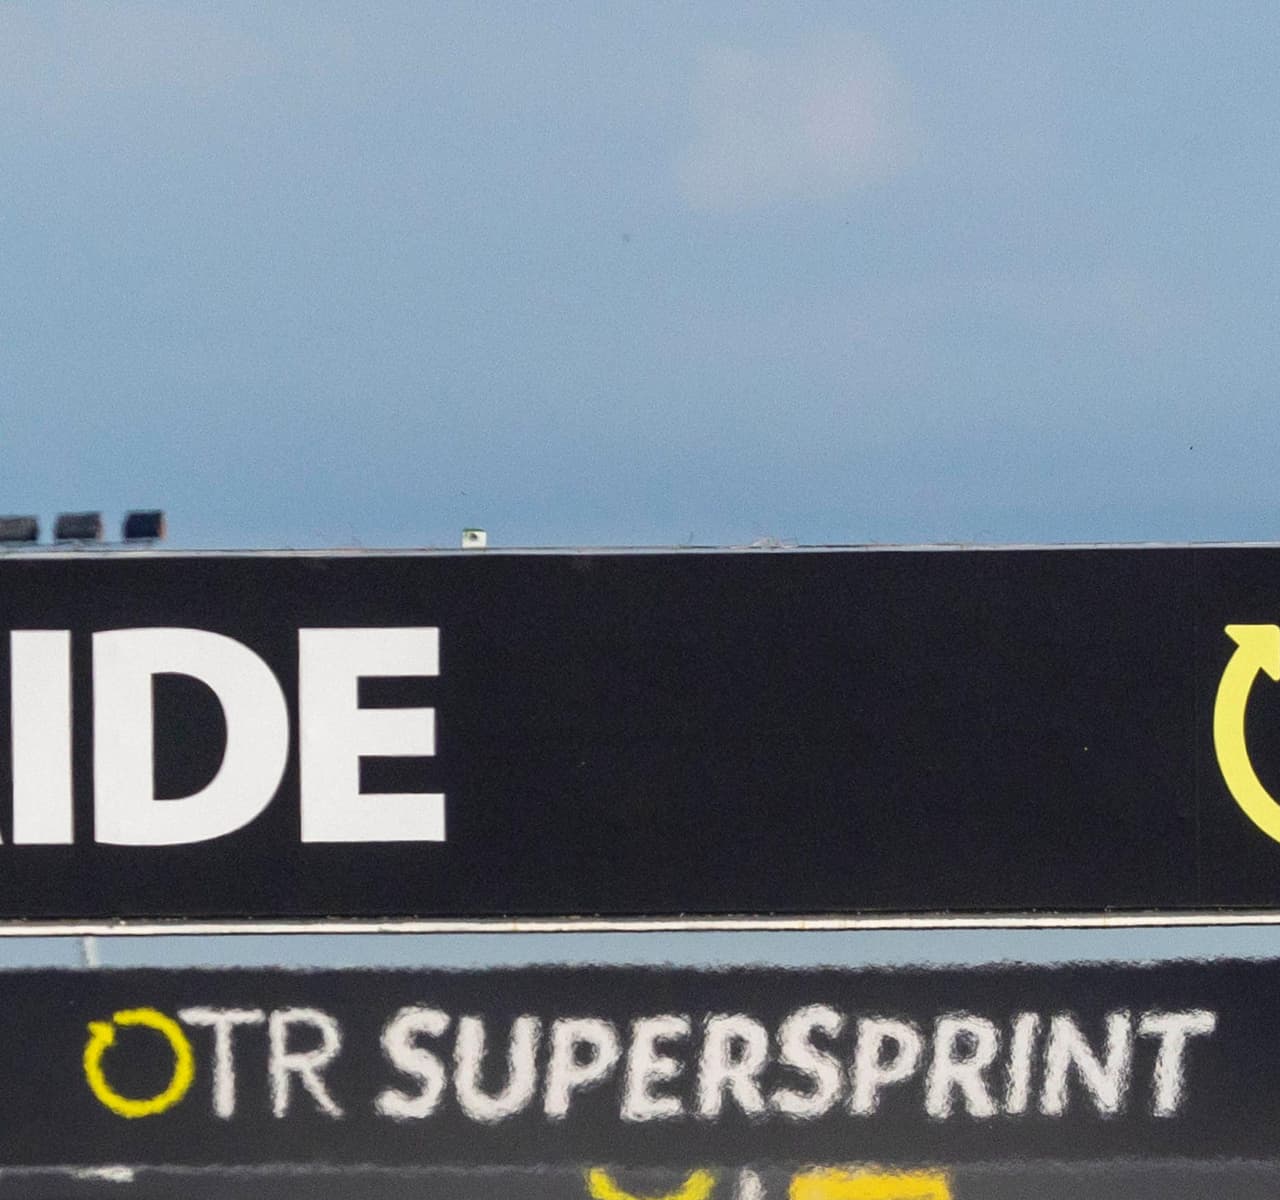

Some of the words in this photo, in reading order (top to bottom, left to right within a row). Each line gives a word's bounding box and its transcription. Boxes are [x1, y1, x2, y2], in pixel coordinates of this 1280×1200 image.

[0, 627, 446, 846] IDE
[84, 1008, 343, 1118] OTR
[374, 1004, 1217, 1124] SUPERSPRINT
